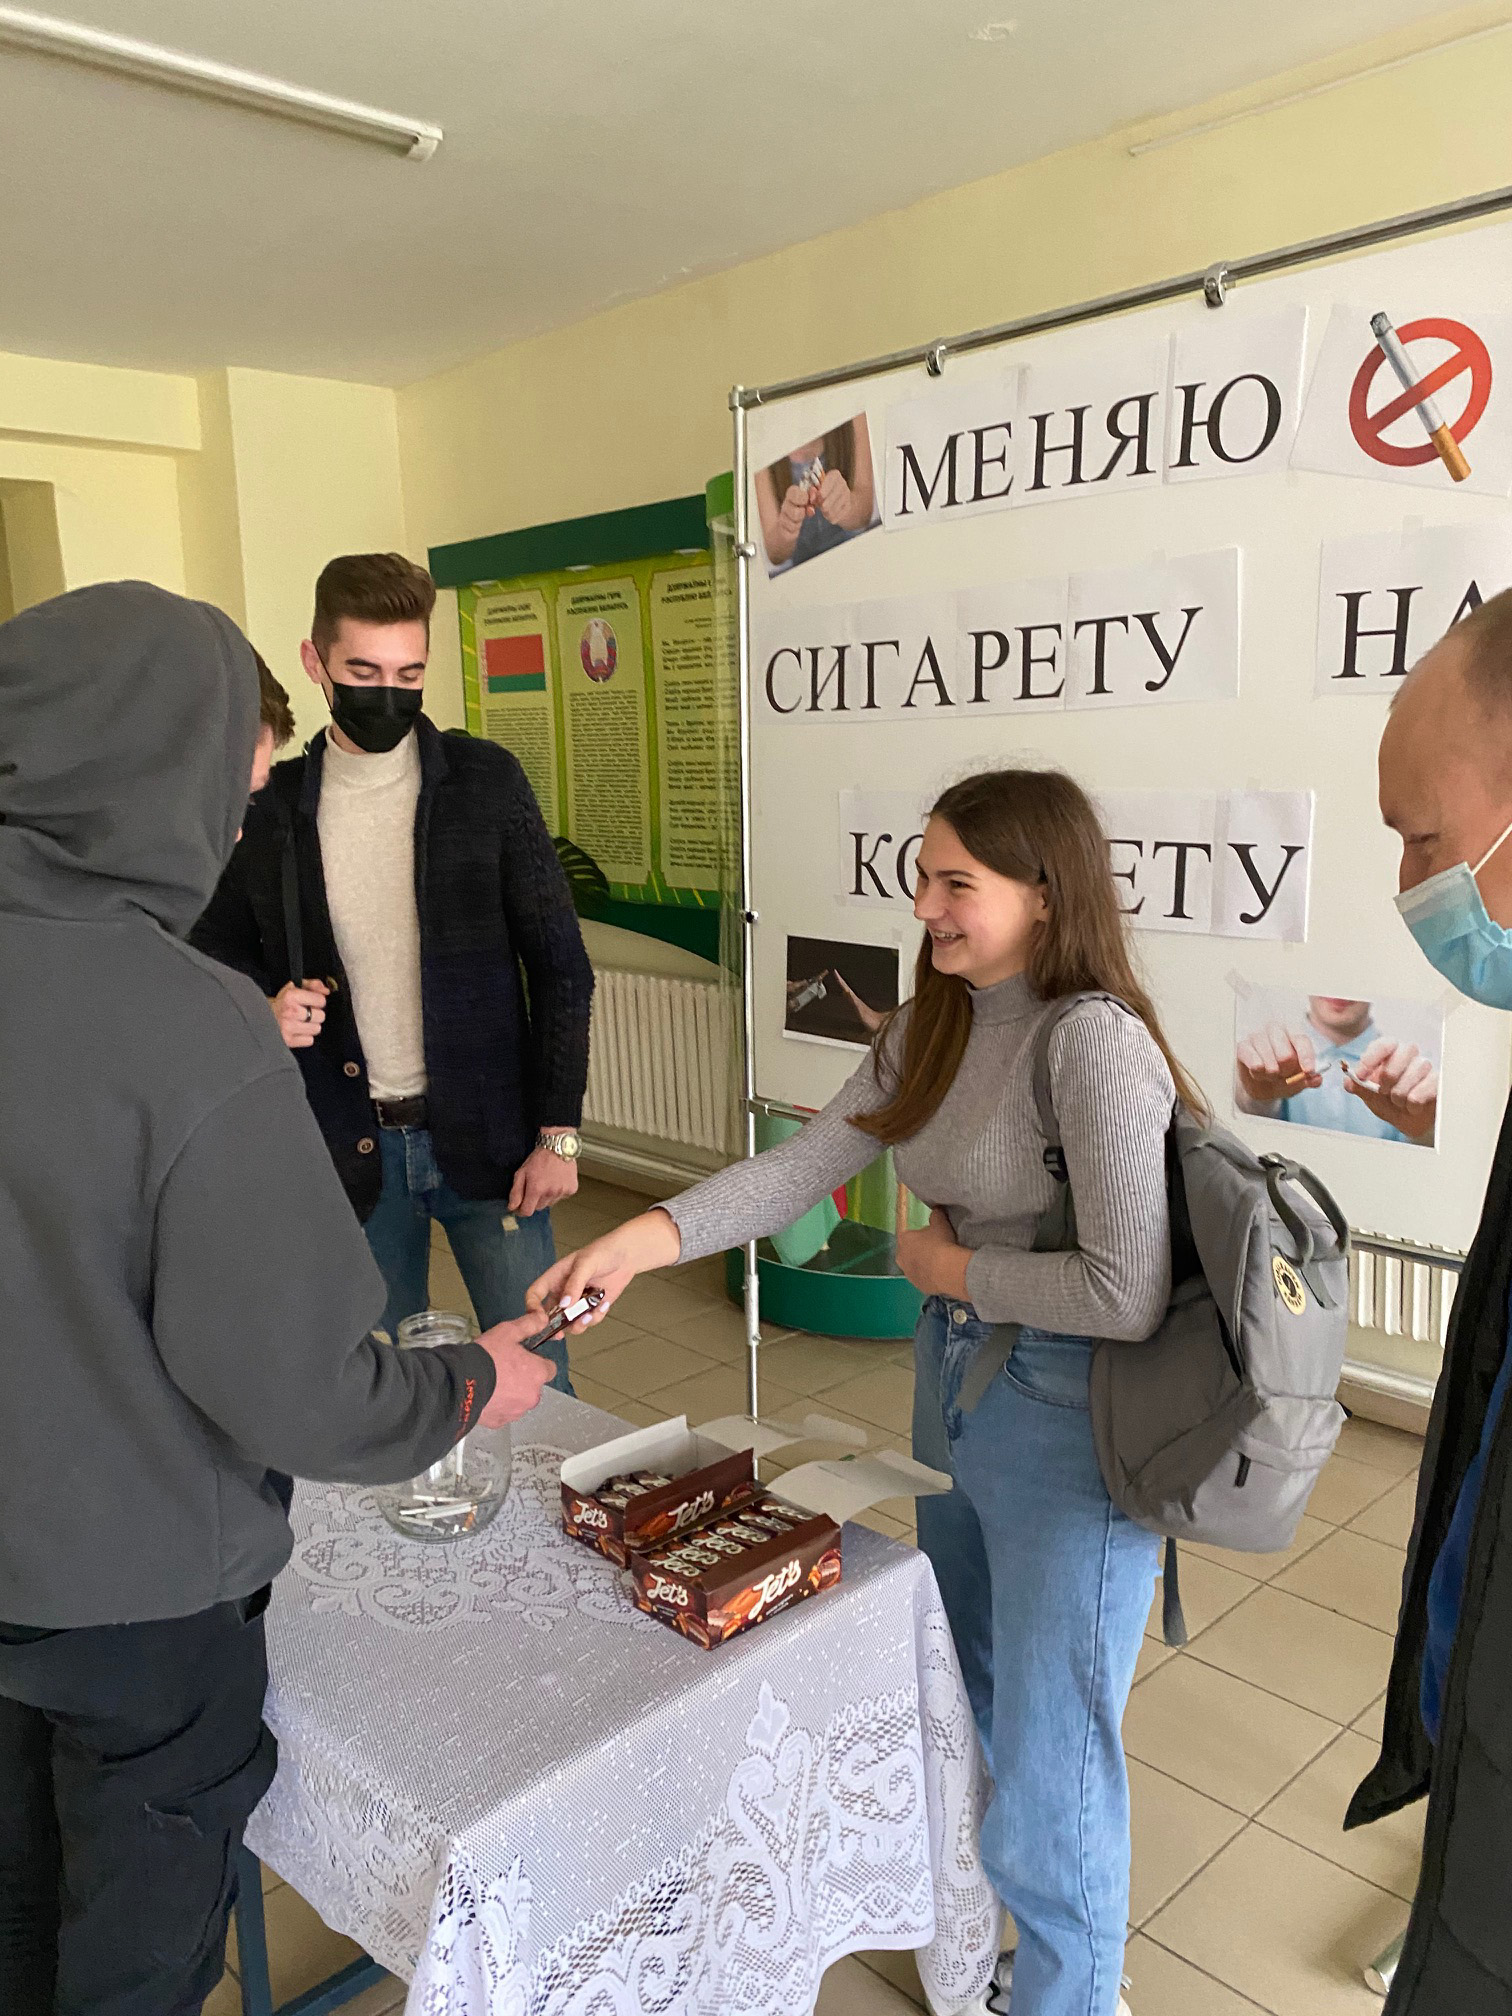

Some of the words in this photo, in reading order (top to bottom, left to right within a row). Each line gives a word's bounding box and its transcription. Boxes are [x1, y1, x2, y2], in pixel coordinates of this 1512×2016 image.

[895, 374, 1282, 515] МЕНЯЮ
[764, 606, 1204, 714] СИГАРЕТУ
[848, 831, 1305, 924] КОЕТУ
[573, 1499, 608, 1528] Jet's
[667, 1490, 715, 1534] Jet's
[646, 1573, 690, 1607] Jet's
[748, 1559, 802, 1620] Jet's
